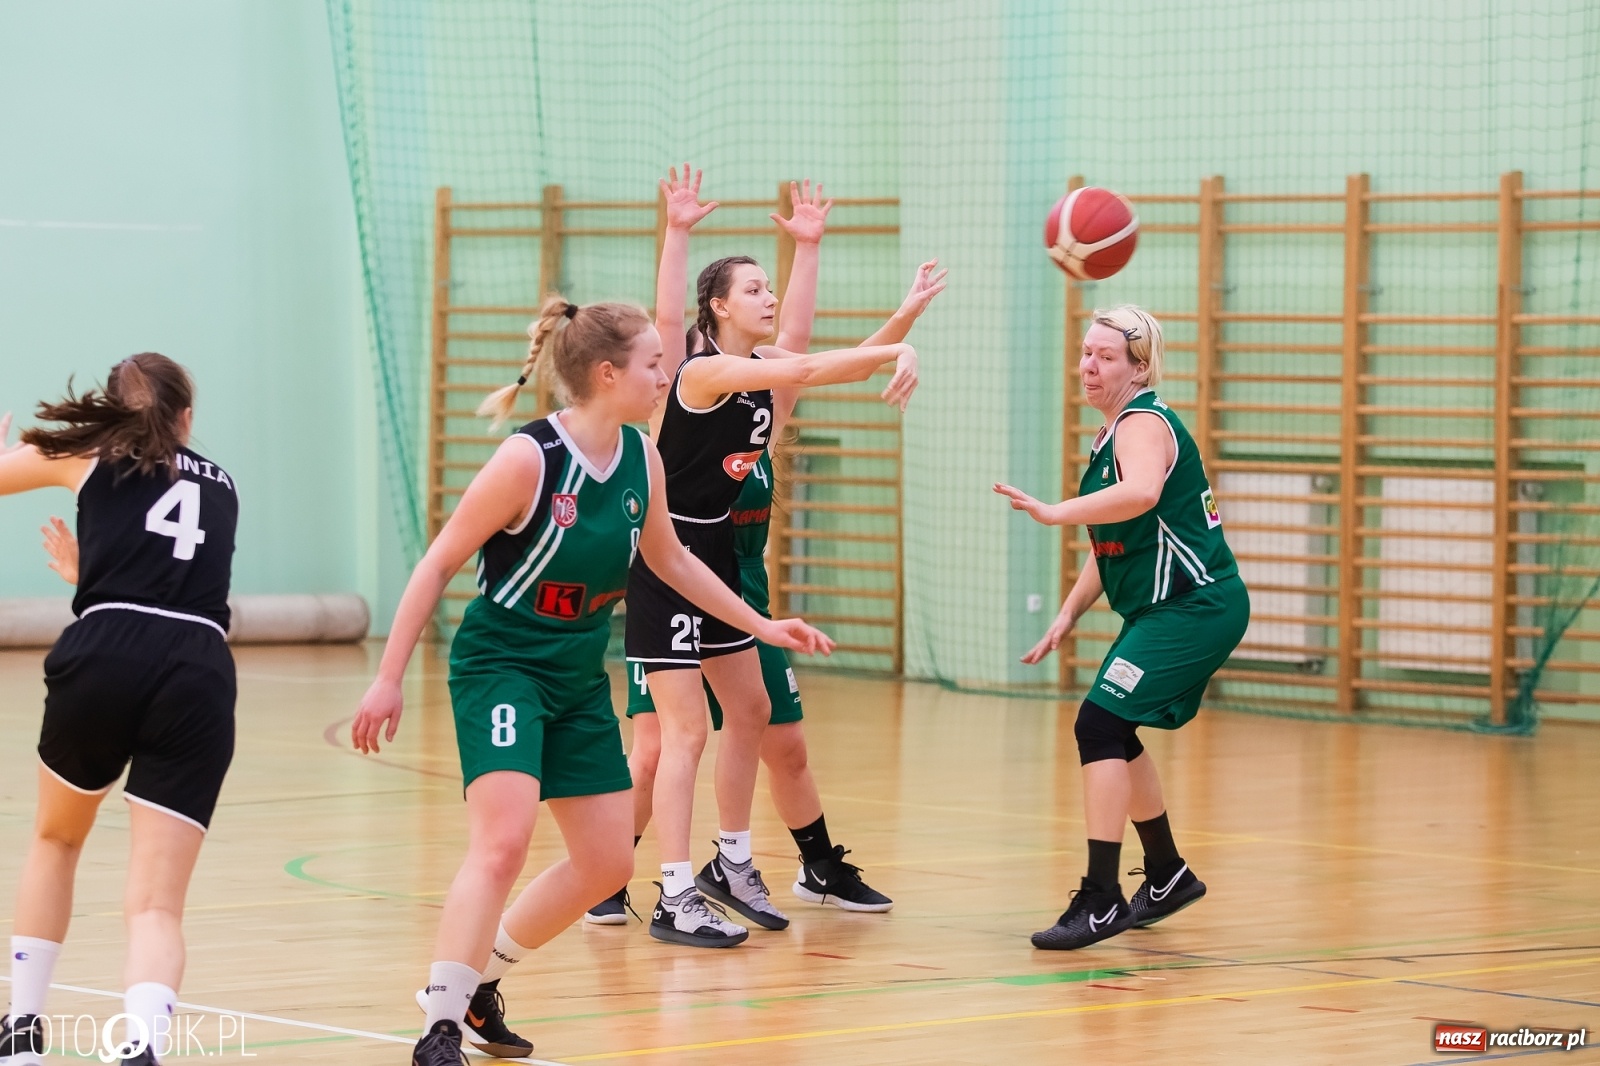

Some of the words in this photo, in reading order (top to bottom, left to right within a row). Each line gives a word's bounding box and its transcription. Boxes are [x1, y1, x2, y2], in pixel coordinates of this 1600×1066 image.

[749, 408, 770, 445] 2
[145, 479, 206, 560] 4
[541, 585, 578, 615] K
[670, 613, 703, 653] 25
[1100, 683, 1126, 699] COLO
[491, 703, 516, 747] 8
